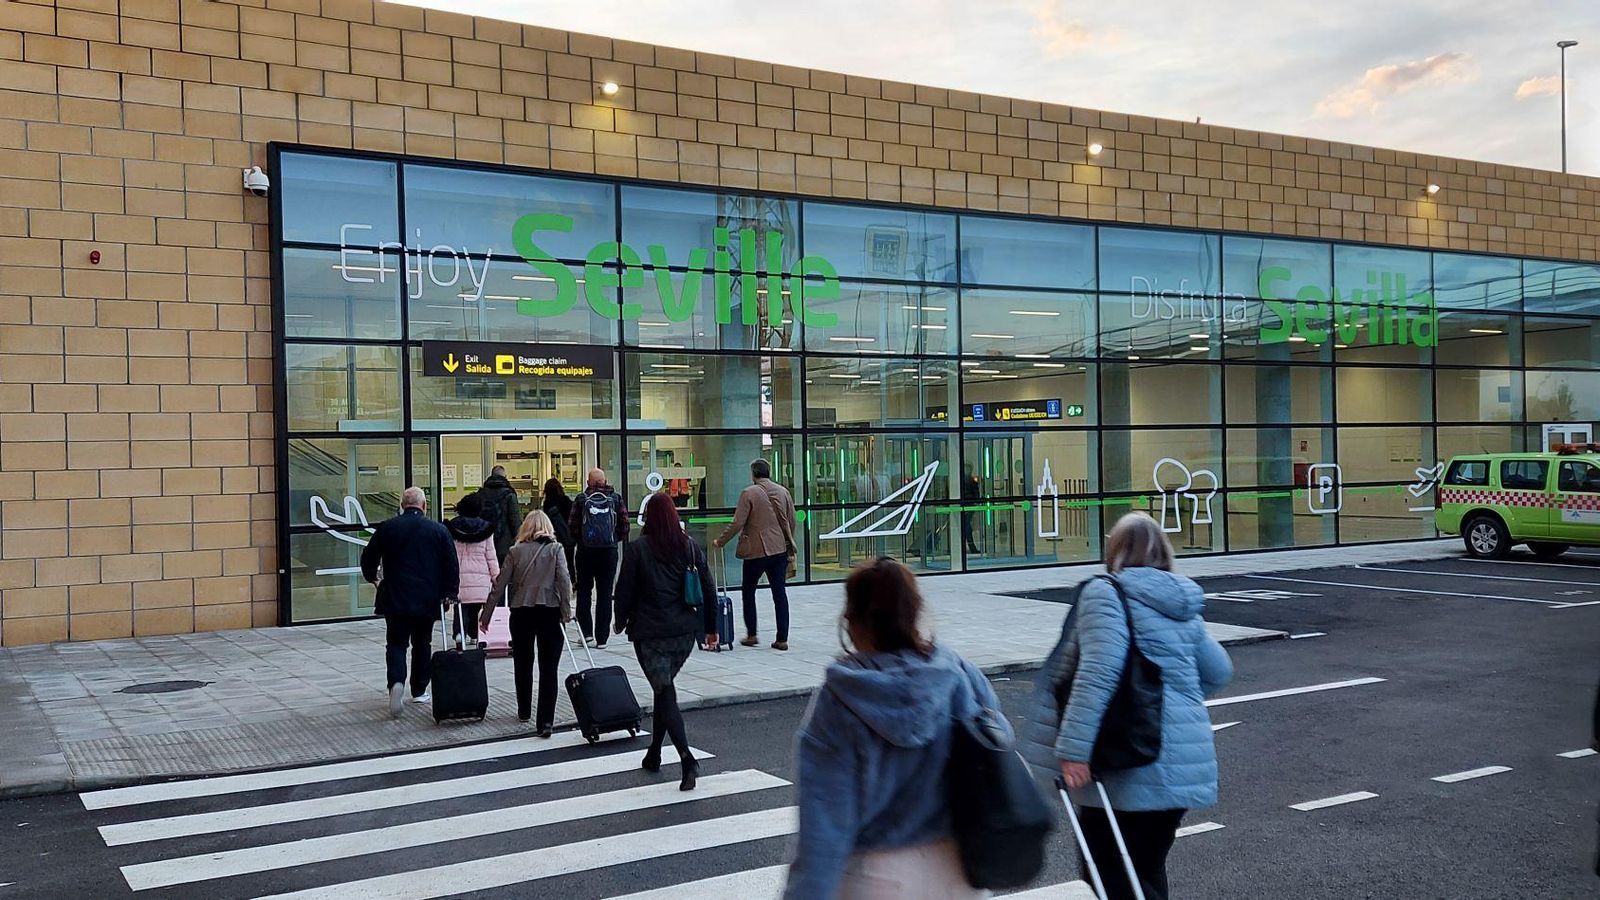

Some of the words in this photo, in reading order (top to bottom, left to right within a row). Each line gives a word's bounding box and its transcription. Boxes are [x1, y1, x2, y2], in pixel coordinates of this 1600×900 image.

[339, 223, 494, 302] Enjoy
[512, 213, 840, 328] Seville
[1130, 276, 1247, 323] Disfruta
[1259, 266, 1438, 347] Sevilla
[465, 354, 479, 363] Exit
[518, 356, 547, 366] Baggage
[548, 357, 568, 365] claim
[465, 364, 492, 374] Salida
[518, 366, 554, 376] Recogida
[556, 367, 593, 377] equipajes
[1319, 475, 1333, 503] P
